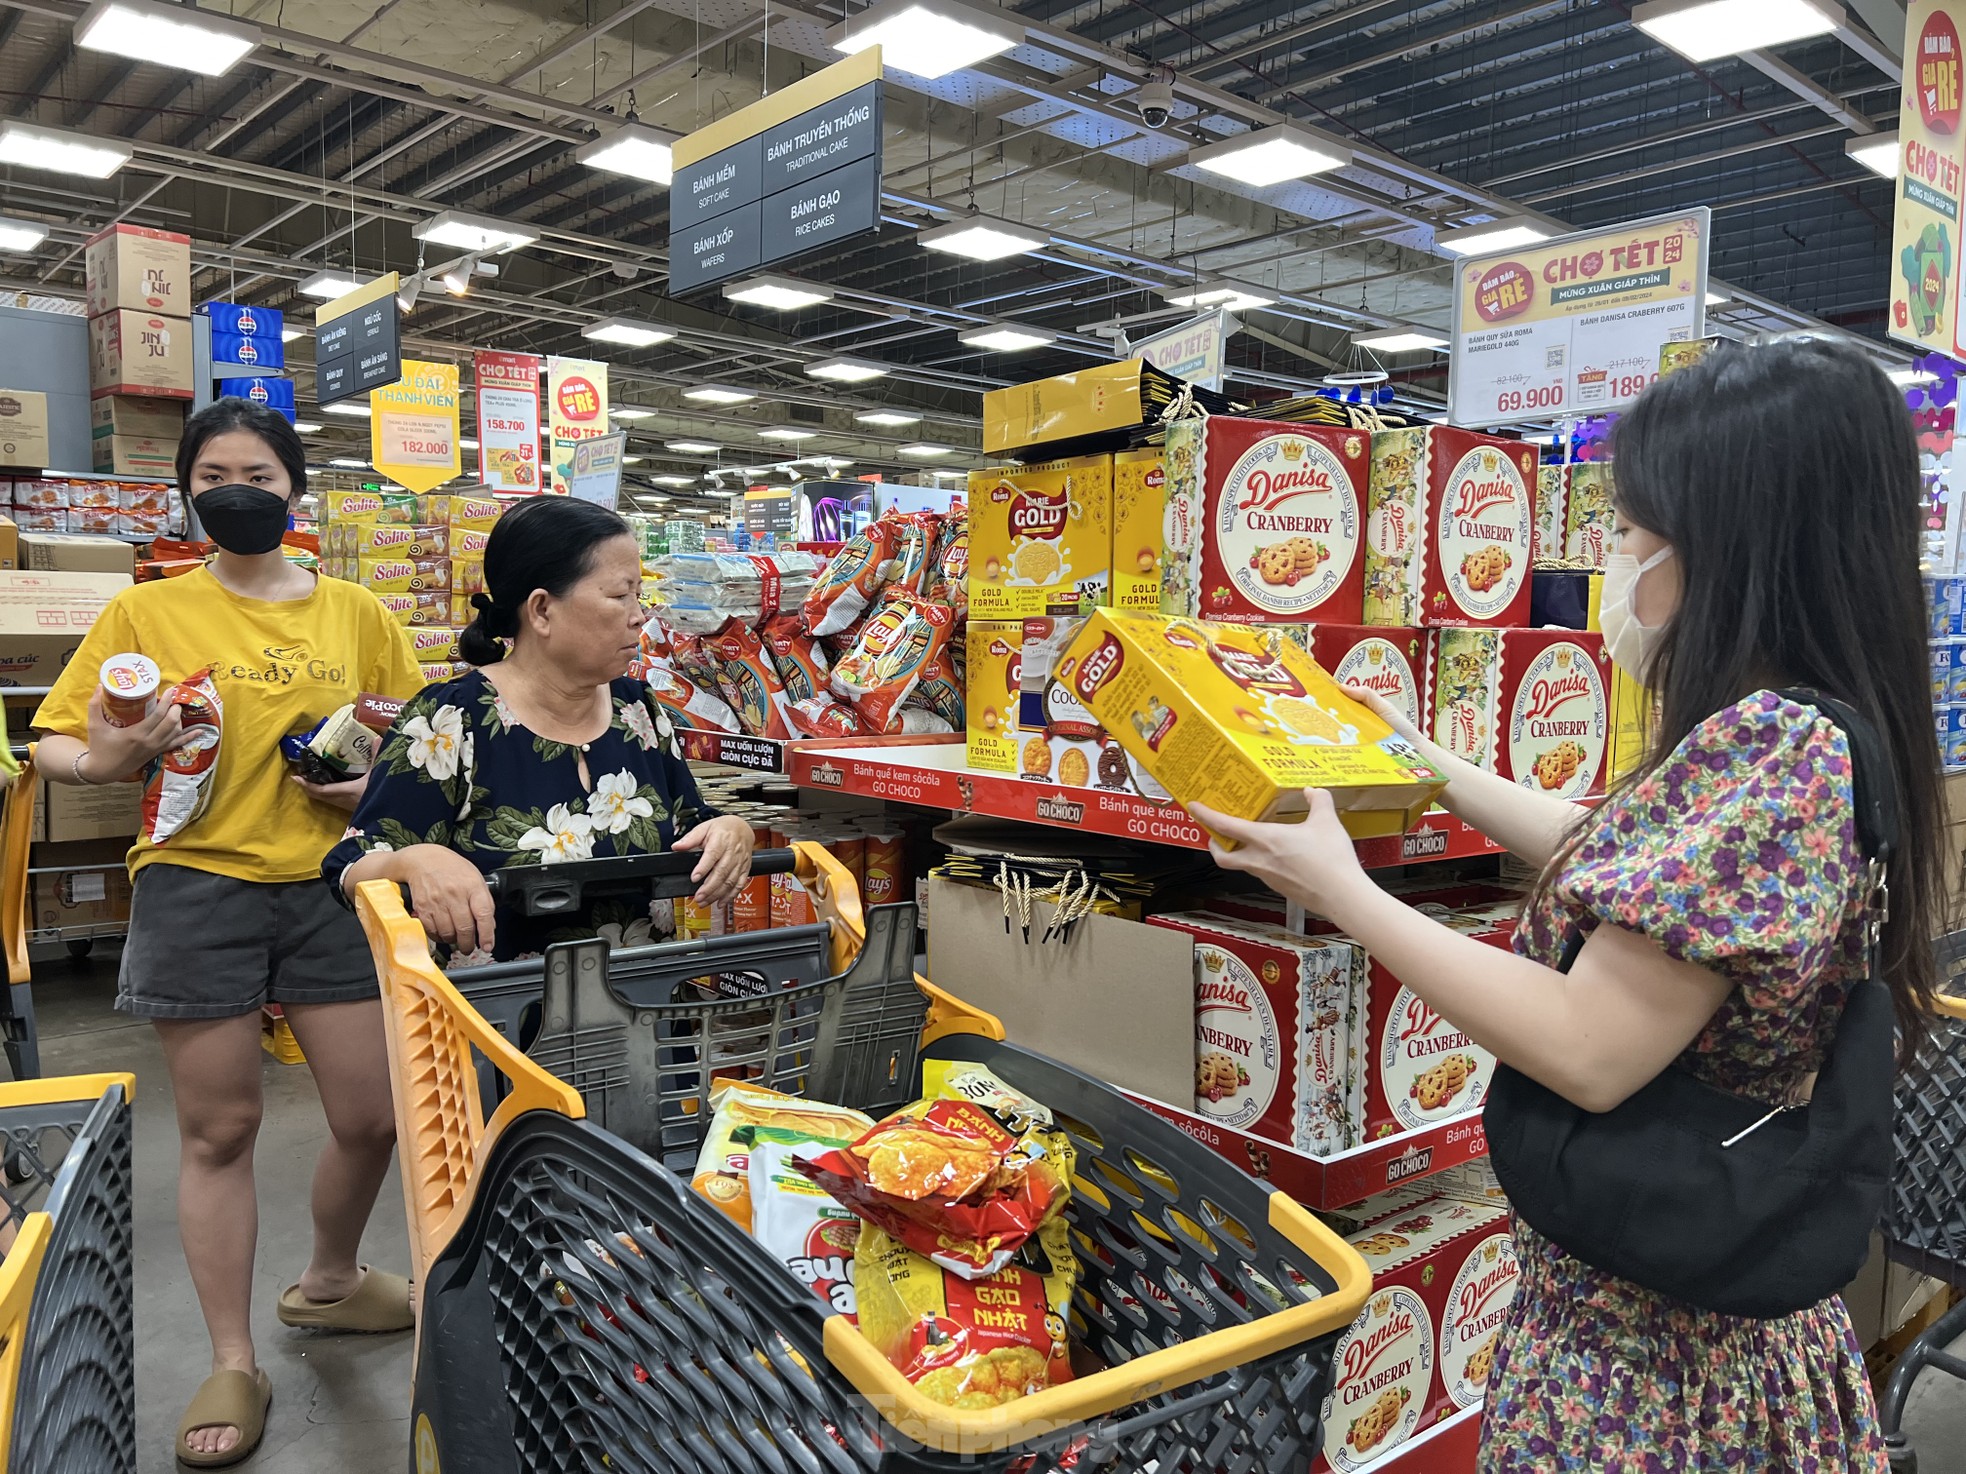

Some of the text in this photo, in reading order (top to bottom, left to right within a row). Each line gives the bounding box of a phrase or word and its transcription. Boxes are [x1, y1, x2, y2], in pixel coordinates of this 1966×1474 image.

[1922, 60, 1936, 86] GIÁ
[767, 104, 870, 161] BÁNH TRUYỀN THỐNG
[786, 136, 848, 173] TRADITIONAL CAKE
[1905, 140, 1960, 195] CHỢ TẾT
[693, 163, 736, 194] BÁNH MỀM
[698, 187, 730, 209] SOFT CAKE
[790, 189, 841, 220] BÁNH GẠO
[795, 213, 835, 237] RICE CAKES
[693, 226, 734, 255] BÁNH XỐP
[1665, 236, 1681, 249] 20
[701, 252, 725, 269] WAFERS
[1543, 238, 1660, 284] CHỢ TẾT
[1664, 249, 1681, 262] 24
[1558, 270, 1661, 300] MỪNG XUÂN GIÁP THÌN
[1924, 277, 1940, 293] 2024
[1580, 303, 1686, 327] BÁNH DANISA CRABERRY 607G
[141, 331, 161, 345] JIN
[1468, 336, 1485, 345] BÁNH
[1486, 333, 1499, 342] QUY
[1514, 327, 1533, 337] ROMA
[148, 344, 165, 358] JU
[1467, 342, 1503, 354] MARIEGOLD
[478, 363, 527, 380] CHỢ TẾT
[1498, 385, 1564, 413] 69.900
[486, 419, 525, 431] 158.700
[555, 425, 581, 440] CHỢ
[402, 441, 448, 455] 182.000
[997, 461, 1071, 477] IMPORTED PRODUCT
[1239, 462, 1332, 511] Danisa
[1454, 474, 1515, 520] Danisa
[342, 496, 379, 513] Solite
[463, 503, 499, 518] Solite
[1014, 509, 1062, 527] GOLD
[1178, 498, 1190, 546] Danisa
[1247, 511, 1333, 533] CRANBERRY
[1389, 503, 1406, 551] Danisa
[373, 530, 411, 547] Solite
[1380, 511, 1388, 552] CRANBERRY
[1459, 519, 1515, 543] CRANBERRY
[374, 564, 412, 580] Solite
[981, 588, 1002, 598] GOLD
[1132, 585, 1157, 593] GOLD
[973, 598, 1010, 608] FORMULA
[1205, 612, 1265, 624] Danisa Cranberry Cookies
[414, 633, 451, 649] Solite
[18, 653, 40, 664] cúc
[1081, 644, 1118, 693] GOLD
[133, 660, 153, 684] STAX
[209, 659, 347, 686] Ready Go!
[1526, 668, 1590, 719] Danisa
[1461, 703, 1475, 754] Danisa
[1531, 720, 1590, 738] CRANBERRY
[720, 739, 775, 758] MAX UỐN LƯỢN
[970, 747, 1007, 758] FORMULA
[978, 738, 998, 748] GOLD
[720, 749, 773, 768] GIÒN CỰC ĐÃ
[812, 770, 842, 787] GO CHOCO
[853, 763, 940, 787] Bánh quế kem sôcôla
[872, 780, 921, 799] GO CHOCO
[1037, 802, 1080, 822] GO CHOCO
[1100, 797, 1130, 813] Bánh
[1127, 818, 1200, 842] GO CHOCO
[1404, 835, 1446, 855] GO CHOCO
[865, 875, 892, 892] Lay's
[1315, 1034, 1328, 1084] Danisa
[1328, 1036, 1336, 1080] CRANBERRY
[956, 1107, 1006, 1143] BÁNH
[1446, 1122, 1485, 1144] Bánh qu
[1469, 1139, 1484, 1154] GO
[1388, 1157, 1430, 1180] GO CHOCO
[975, 1286, 1020, 1308] GẠO
[1455, 1257, 1519, 1328] Danisa
[973, 1308, 1028, 1333] NHẬT
[977, 1329, 1001, 1338] Japanese
[1014, 1334, 1032, 1345] Cracker
[1337, 1311, 1414, 1390] Danisa
[1343, 1357, 1414, 1405] CRANBERRY
